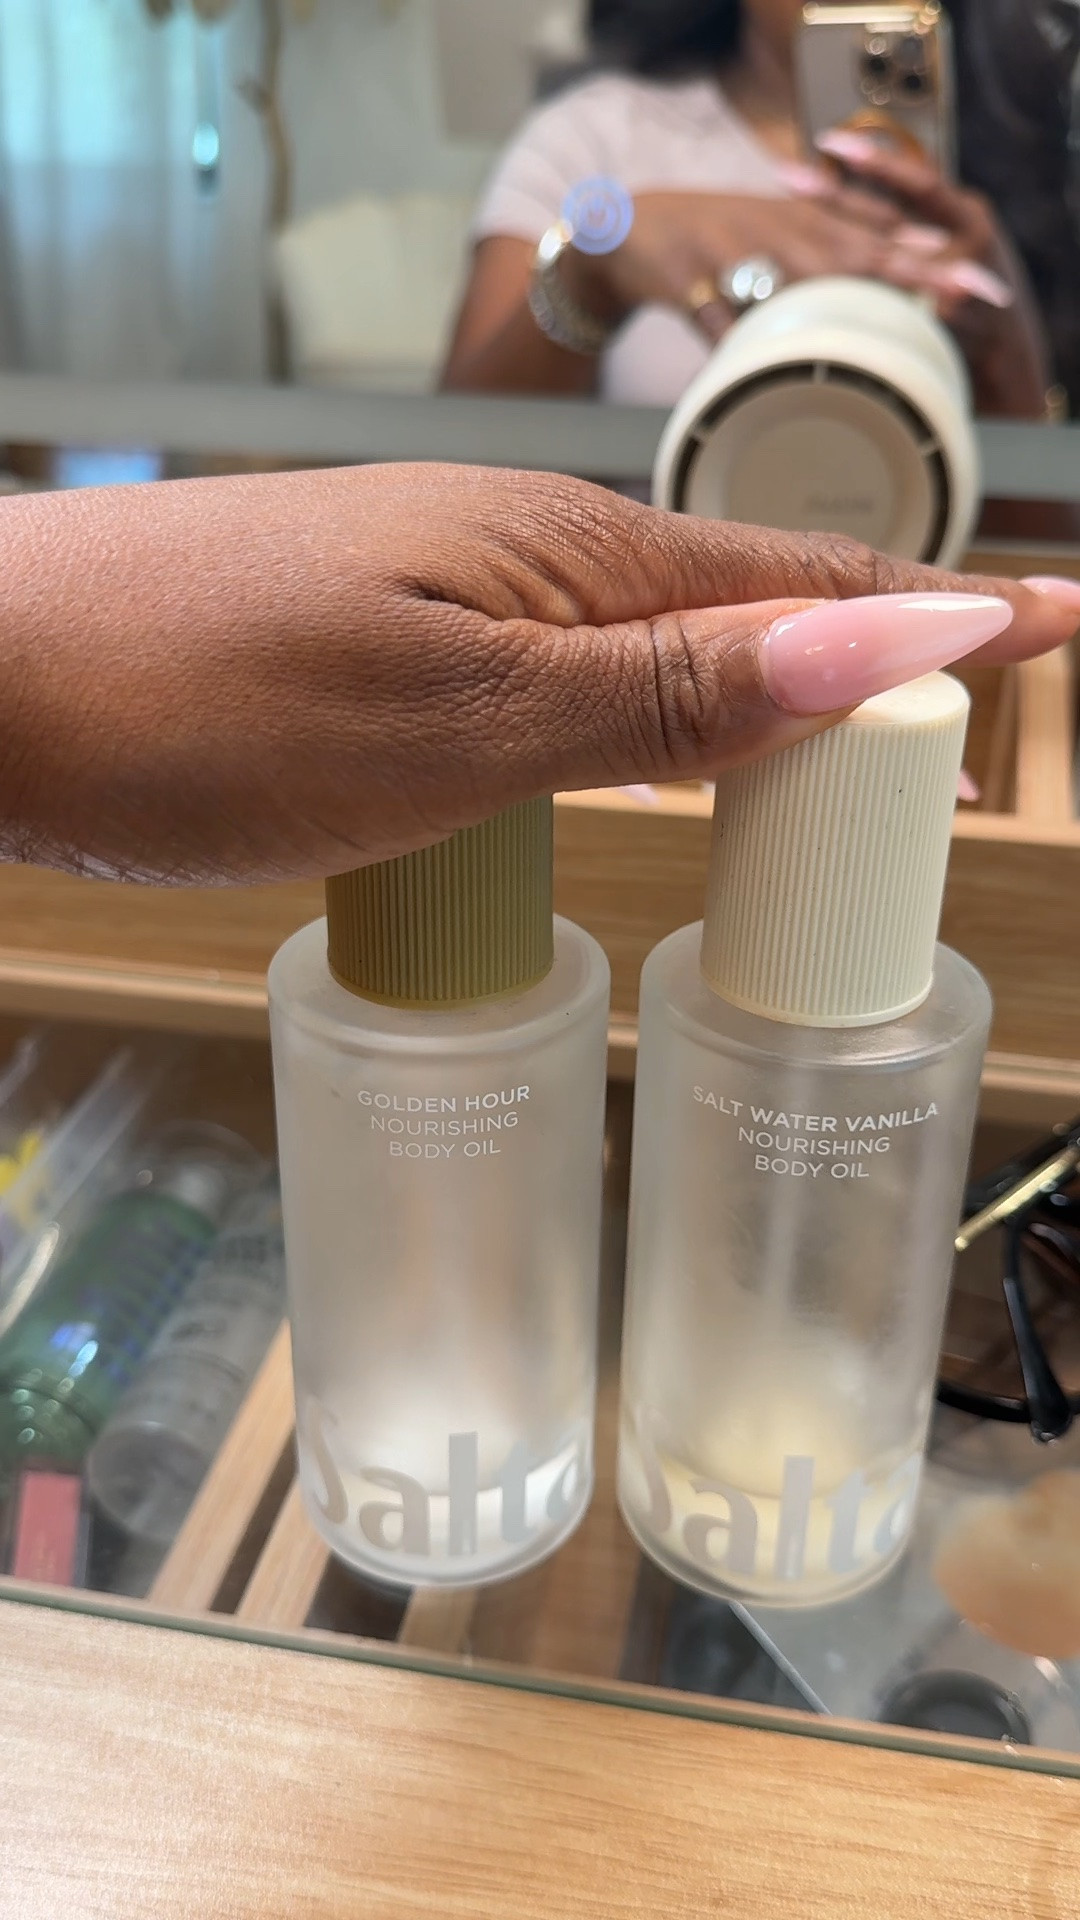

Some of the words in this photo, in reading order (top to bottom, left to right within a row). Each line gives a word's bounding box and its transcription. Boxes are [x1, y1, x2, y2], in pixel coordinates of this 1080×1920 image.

[358, 1090, 456, 1112] GOLDEN
[465, 1085, 530, 1111] HOUR
[692, 1085, 743, 1117] SALT
[750, 1105, 837, 1132] WATER
[845, 1102, 939, 1132] VANILLA
[370, 1111, 519, 1136] NOURISHING
[389, 1141, 456, 1159] BODY
[463, 1139, 502, 1158] OIL
[738, 1127, 891, 1155] NOURISHING
[754, 1155, 825, 1178] BODY
[830, 1162, 870, 1179] OIL
